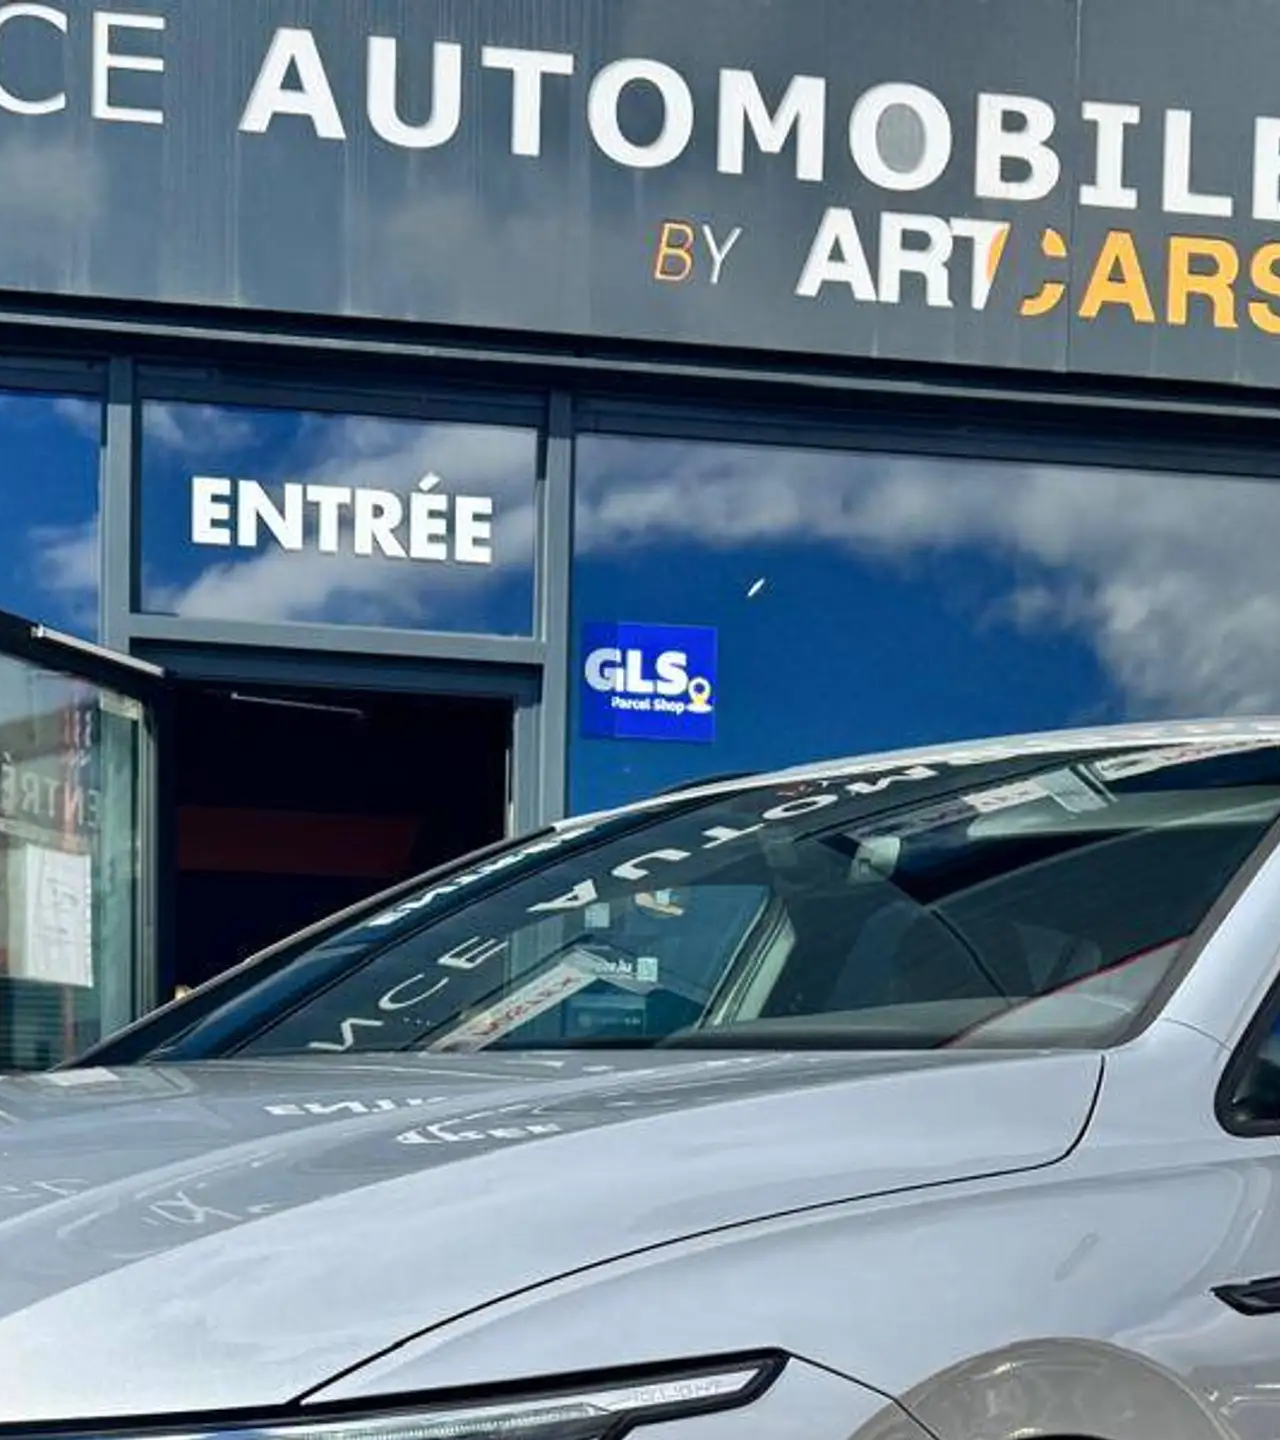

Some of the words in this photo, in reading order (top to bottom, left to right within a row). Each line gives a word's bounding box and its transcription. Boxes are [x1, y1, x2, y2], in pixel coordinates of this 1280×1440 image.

[652, 219, 742, 285] BY
[191, 472, 493, 565] ENTRÉE
[584, 647, 689, 696] GLS
[611, 696, 651, 711] Parcel
[653, 698, 685, 716] Shop
